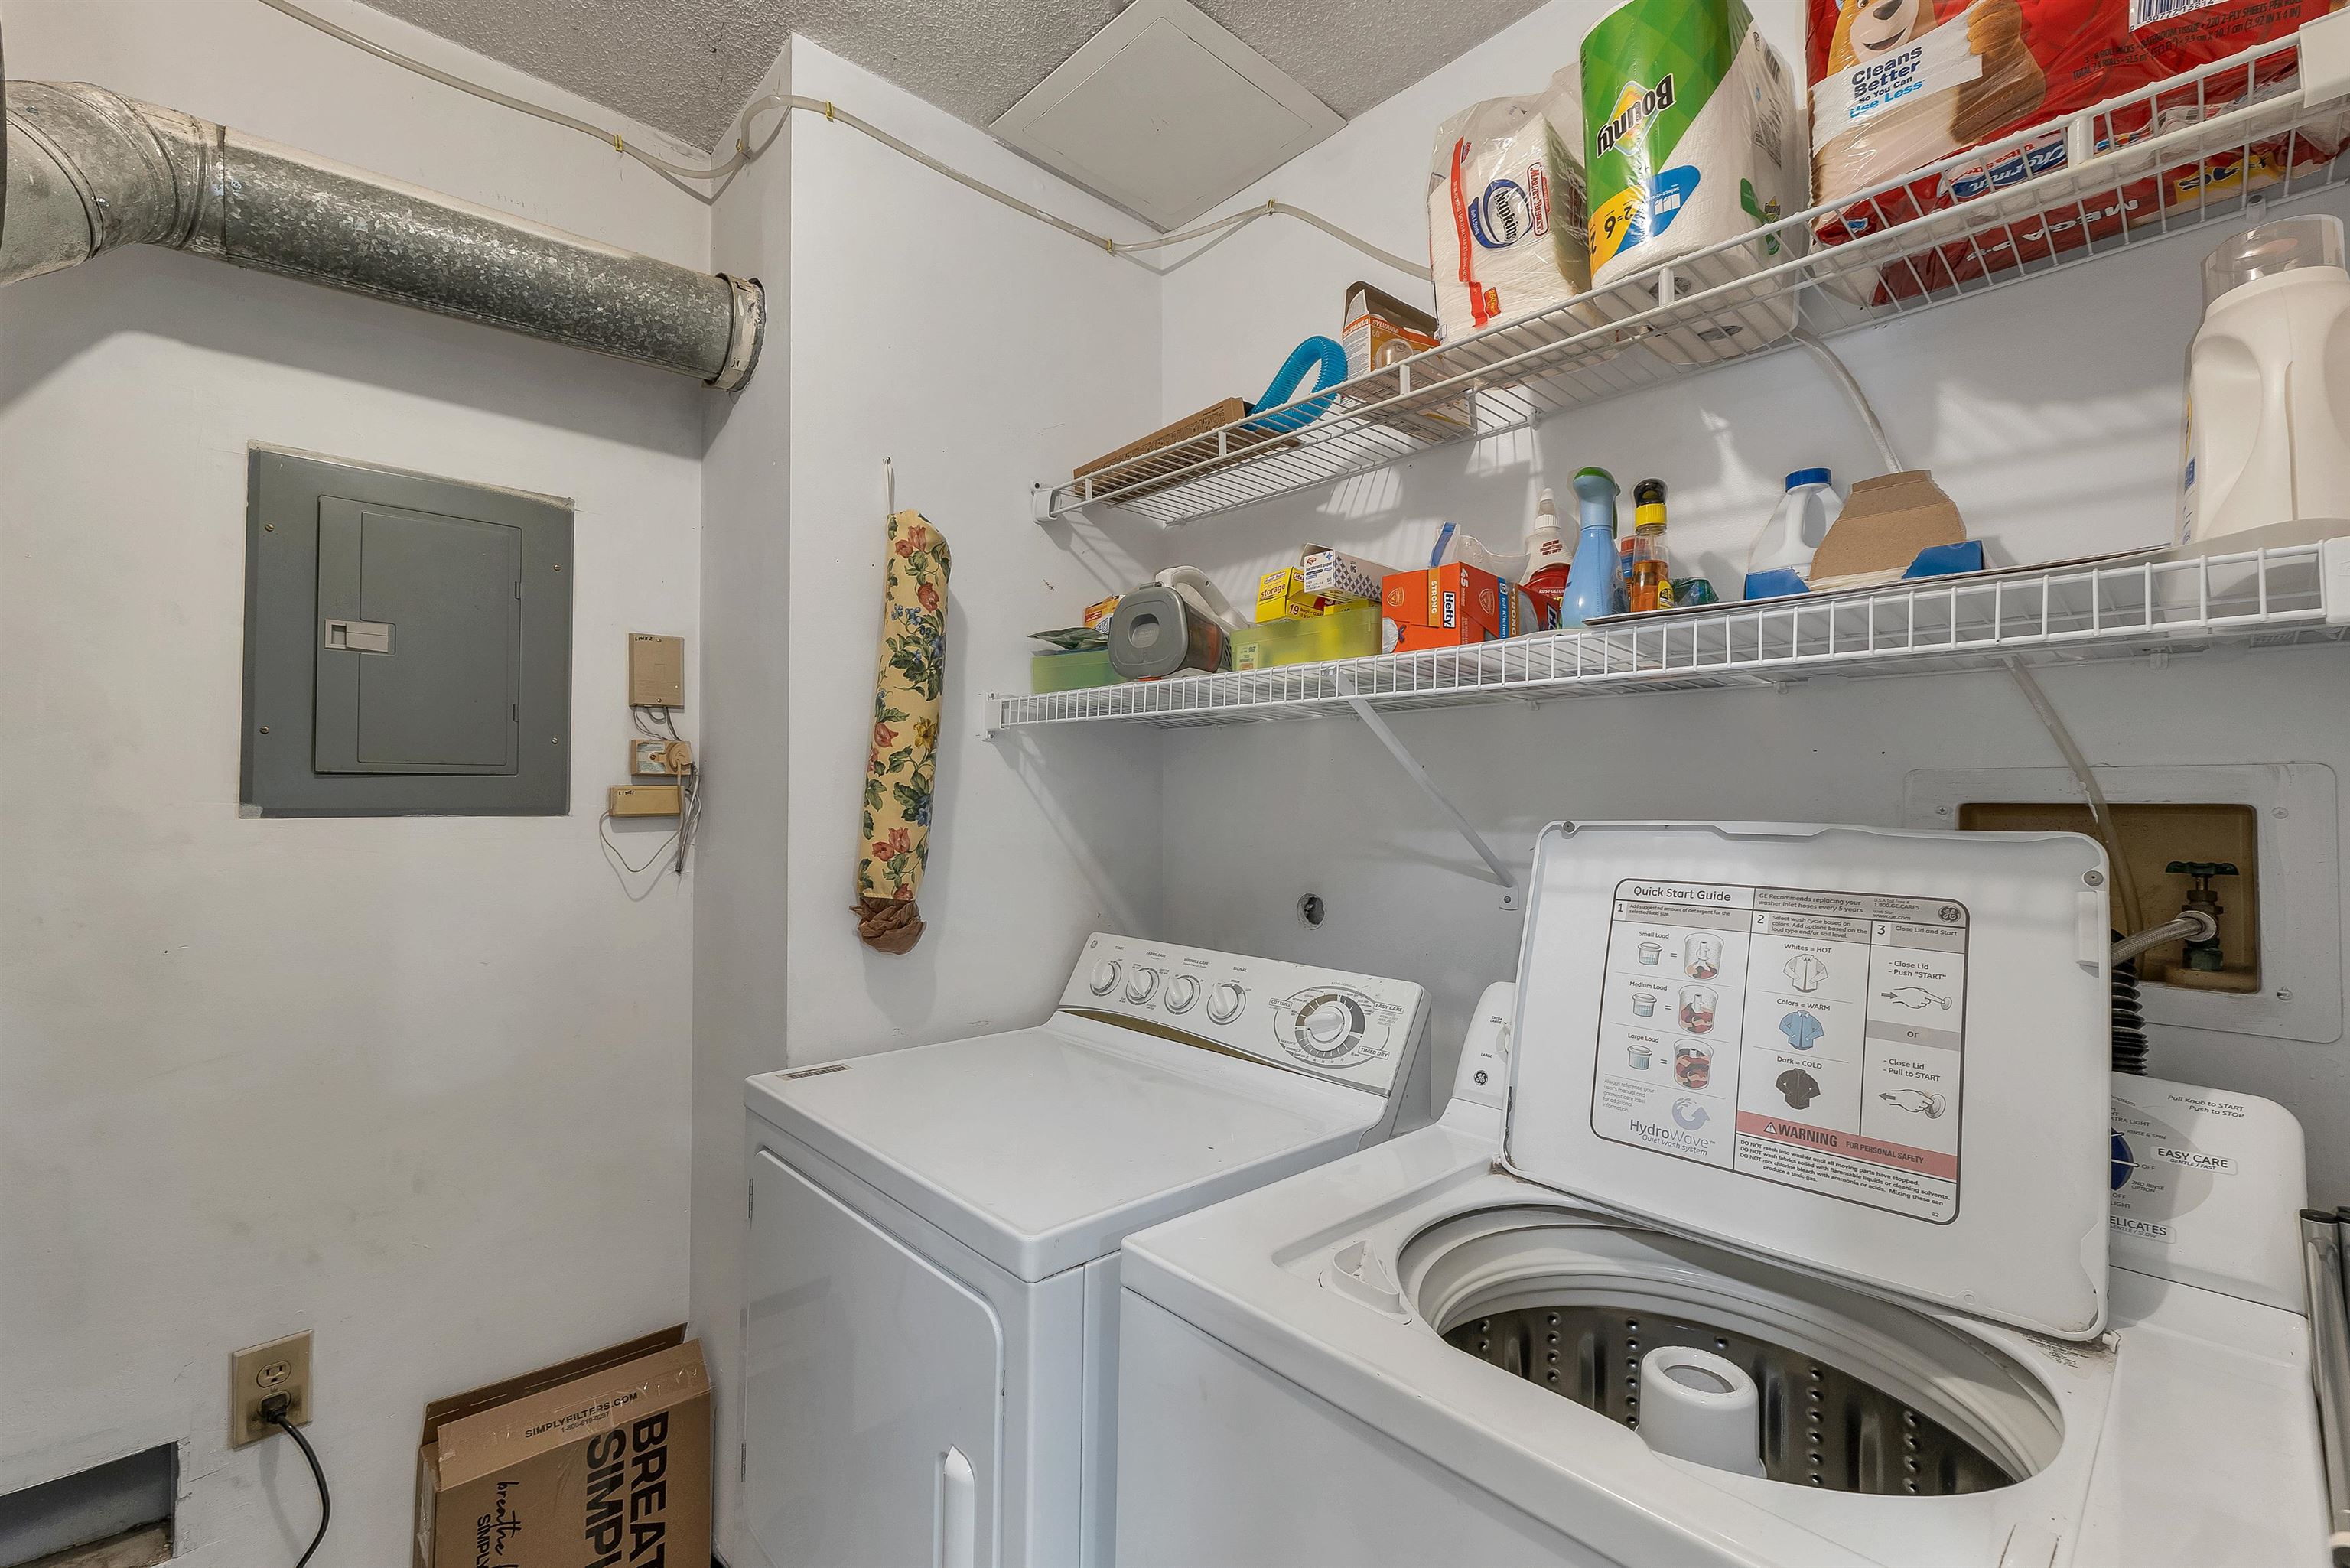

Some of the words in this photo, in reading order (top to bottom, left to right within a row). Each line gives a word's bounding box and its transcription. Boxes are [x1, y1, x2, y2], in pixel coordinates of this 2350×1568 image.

[2147, 9, 2178, 23] 30772
[1851, 47, 1922, 86] Cleans
[1854, 60, 1921, 99] Better
[1874, 86, 1890, 97] You
[1893, 76, 1912, 89] Can
[1850, 100, 1880, 119] Use
[1885, 80, 1922, 103] Less
[1597, 73, 1676, 158] Bounty
[1495, 190, 1518, 241] Napkins
[1343, 319, 1369, 337] SYLVANIA
[1372, 320, 1399, 334] SYLVANIA
[1460, 568, 1469, 587] 45
[1261, 584, 1286, 599] storage
[1289, 604, 1300, 615] 19
[1444, 594, 1454, 627] Hefty
[1633, 886, 1664, 897] Quick
[1666, 888, 1694, 899] Start
[1697, 890, 1731, 902] Guide
[1769, 893, 1811, 902] Recommends
[1812, 897, 1844, 906] replacing
[1617, 903, 1623, 912] 1
[1756, 914, 1765, 924] 2
[1877, 925, 1886, 935] 3
[1784, 943, 1808, 952] Whites
[1915, 971, 1946, 980] "START"
[1777, 998, 1799, 1007] Colors
[1807, 1002, 1831, 1011] WARM
[1628, 1033, 1644, 1041] Large
[1777, 1056, 1794, 1065] Dark
[1802, 1060, 1822, 1069] COLD
[1889, 1059, 1910, 1067] Close
[1915, 1072, 1941, 1082] START
[2218, 1103, 2244, 1111] START
[1642, 1134, 1661, 1144] Quiet
[1662, 1139, 1681, 1149] wash
[1681, 1145, 1707, 1156] system
[1778, 1123, 1837, 1147] WARNING
[1846, 1141, 1859, 1150] FOR
[1860, 1144, 1896, 1158] PERSONAL
[1897, 1152, 1924, 1164] SAFETY
[2157, 1148, 2189, 1160] EASY
[2193, 1154, 2228, 1168] CARE
[2169, 1158, 2195, 1167] GENTLE
[1791, 1151, 1811, 1160] washer
[1835, 1163, 1858, 1173] moving
[1892, 1175, 1920, 1186] stopped.
[1779, 1155, 1796, 1164] fabrics
[1798, 1160, 1815, 1168] soiled
[1830, 1167, 1862, 1179] flammable
[1863, 1175, 1883, 1184] liquids
[1893, 1183, 1919, 1193] cleaning
[1921, 1189, 1951, 1201] solvents.
[2146, 1183, 2165, 1191] RINSE
[525, 1391, 638, 1438] SIMPLYFILTERS.COM
